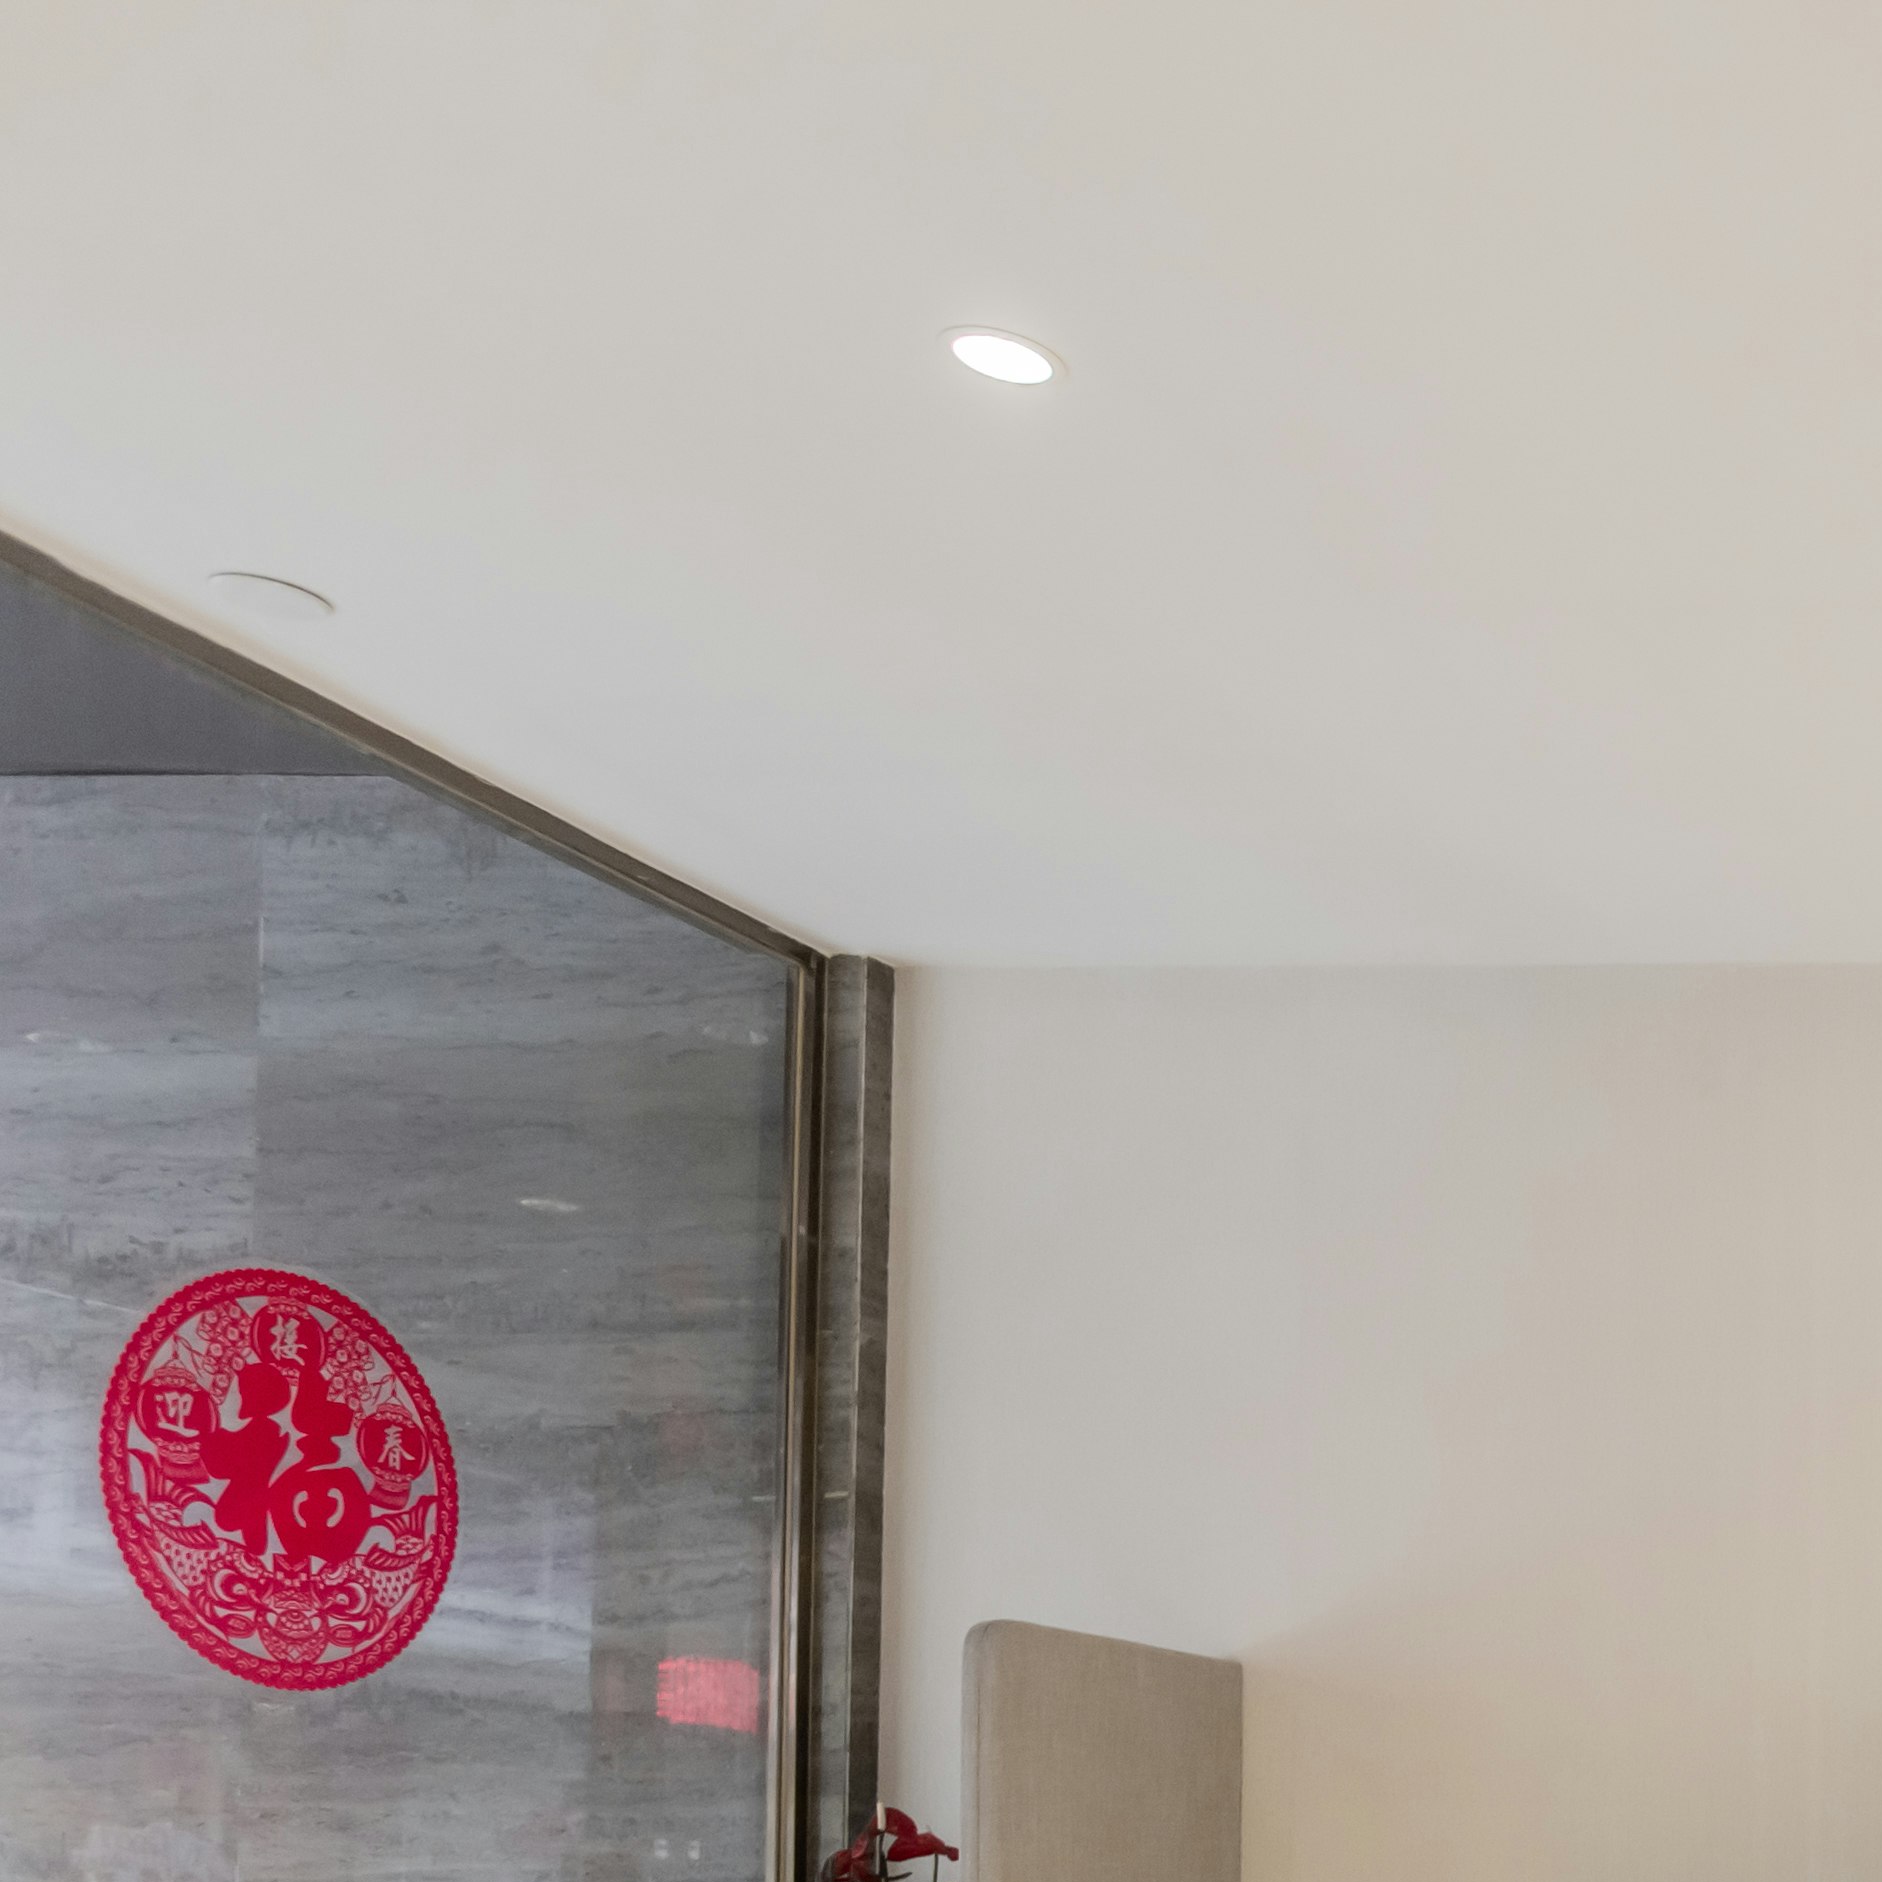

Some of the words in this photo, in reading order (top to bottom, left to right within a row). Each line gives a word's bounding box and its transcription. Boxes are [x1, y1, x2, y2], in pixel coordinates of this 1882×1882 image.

[155, 1391, 200, 1438] 迎
[200, 1362, 371, 1564] 福
[377, 1424, 416, 1470] 春
